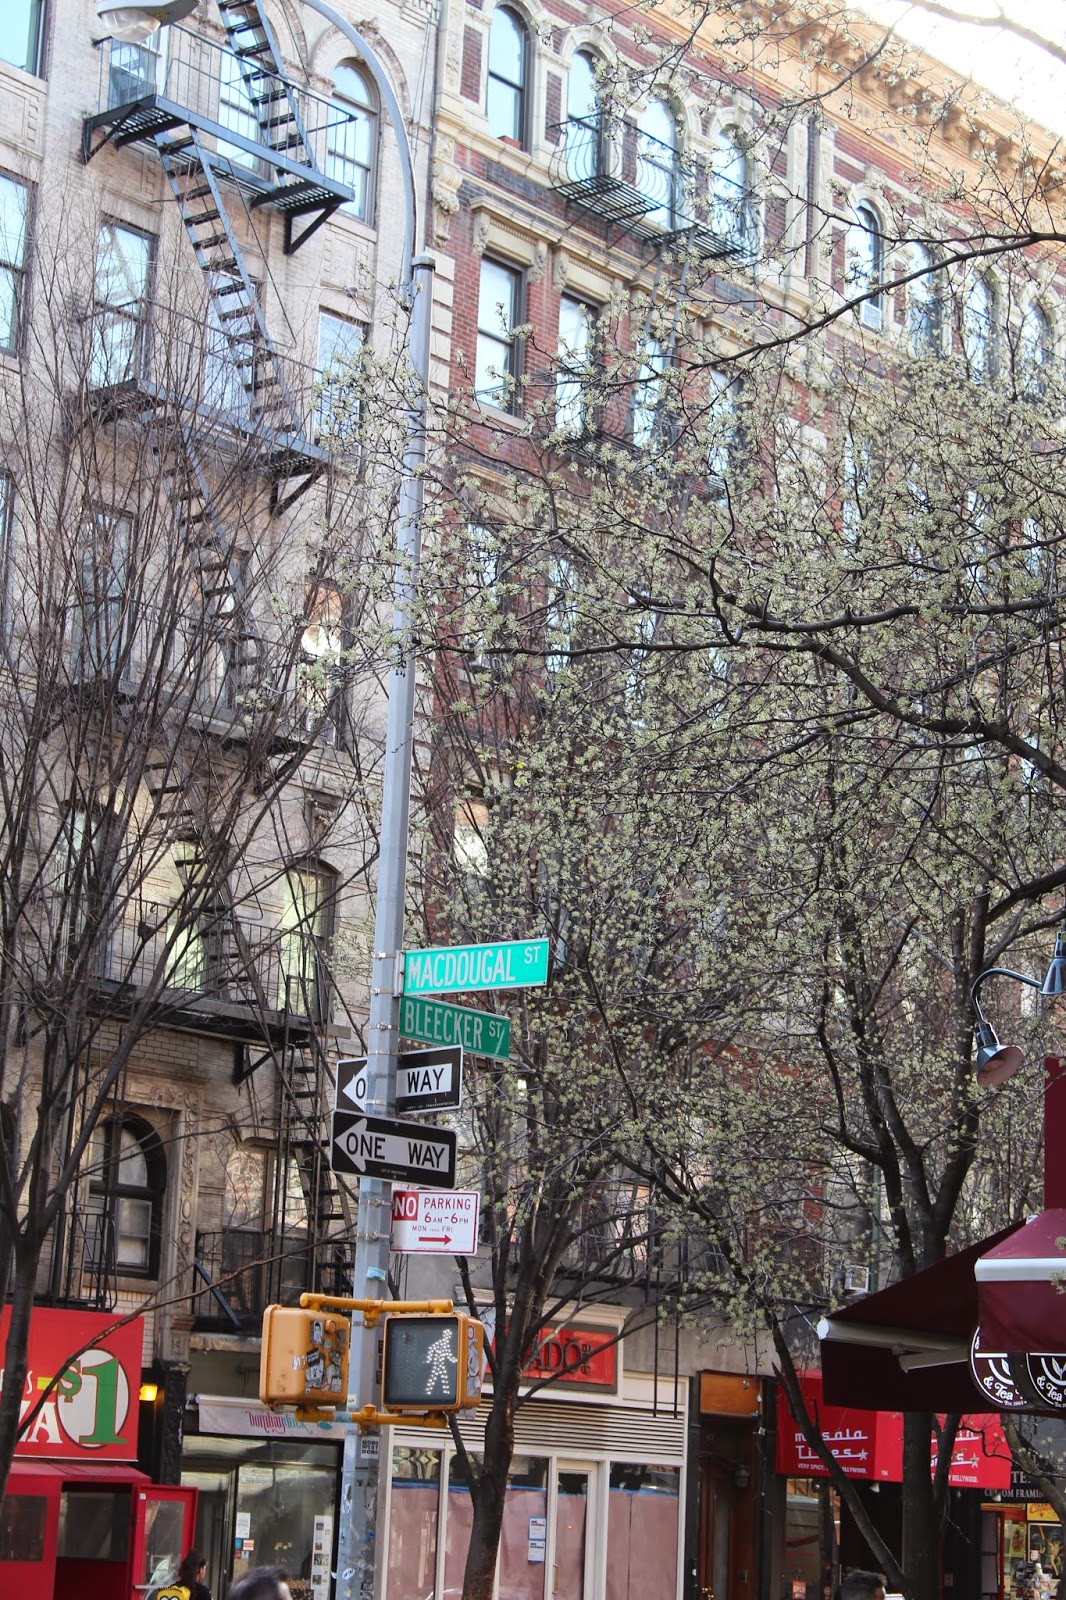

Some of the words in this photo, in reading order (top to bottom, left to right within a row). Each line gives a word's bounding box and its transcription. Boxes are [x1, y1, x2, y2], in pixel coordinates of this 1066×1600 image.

[407, 949, 516, 989] MACDOUGAL
[523, 946, 541, 965] ST
[404, 1001, 483, 1049] BLEECKER
[488, 1020, 503, 1038] ST
[407, 1067, 445, 1094] WAY
[346, 1132, 386, 1160] ONE
[408, 1141, 446, 1169] WAY
[394, 1196, 417, 1217] NO
[423, 1197, 471, 1210] PARKING
[994, 1383, 1013, 1400] Tea
[1045, 1383, 1062, 1401] Tea
[794, 1428, 868, 1442] msala
[795, 1445, 860, 1460] Ties
